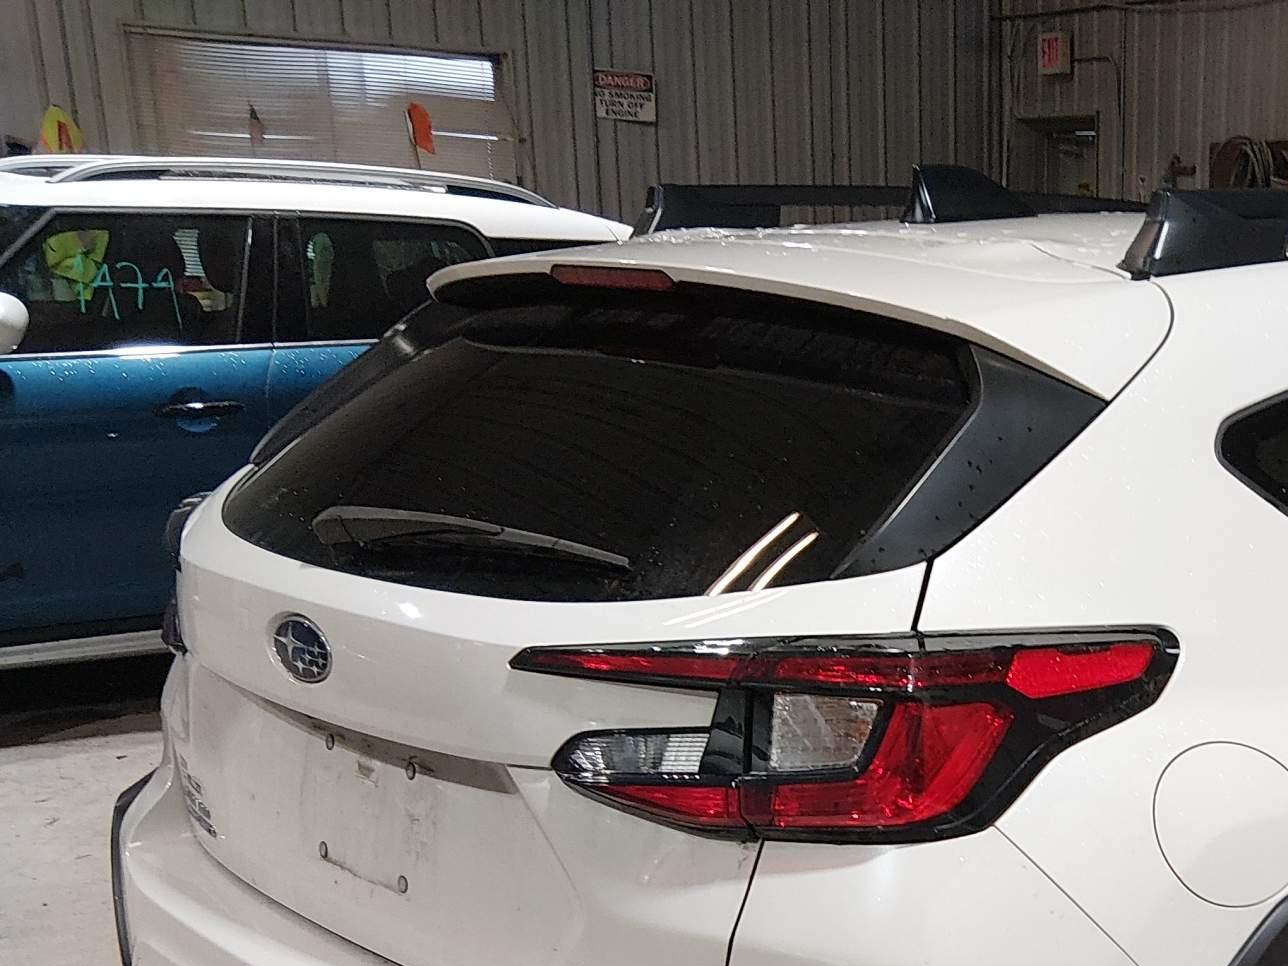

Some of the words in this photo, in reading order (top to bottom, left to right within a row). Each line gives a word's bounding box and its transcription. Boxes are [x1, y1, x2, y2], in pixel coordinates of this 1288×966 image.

[598, 74, 646, 89] DANGER
[608, 91, 652, 103] SMOKING
[600, 99, 625, 109] TURN
[605, 108, 641, 118] ENGINE
